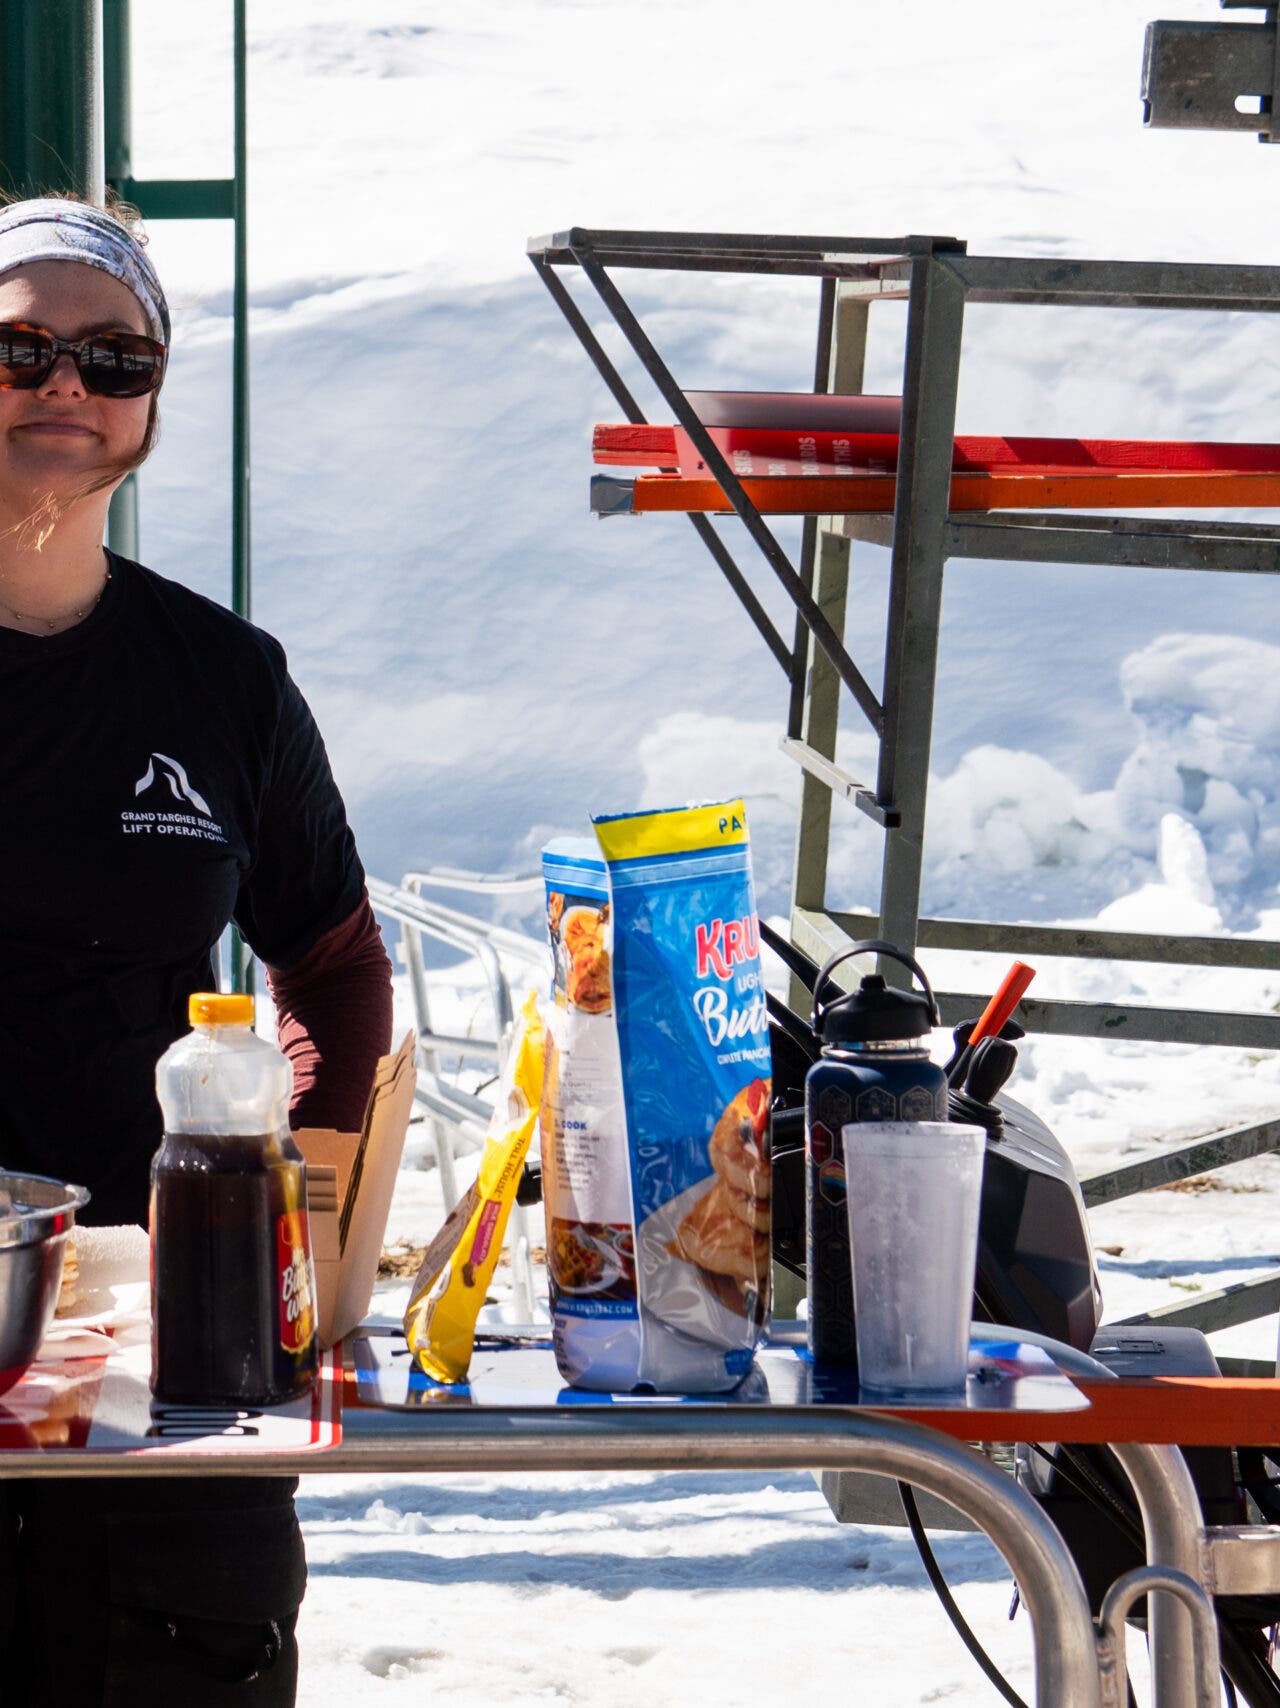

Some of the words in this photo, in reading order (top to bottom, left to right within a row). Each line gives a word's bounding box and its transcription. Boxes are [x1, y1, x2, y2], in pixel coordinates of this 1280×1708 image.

[733, 450, 753, 474] SKIS
[121, 811, 156, 821] GRAND
[157, 812, 197, 825] TARGHEE
[198, 817, 223, 834] RESORT
[123, 824, 153, 834] LIFT
[719, 811, 746, 834] PA
[562, 1120, 587, 1131] COOK
[495, 1160, 514, 1197] HOUSE
